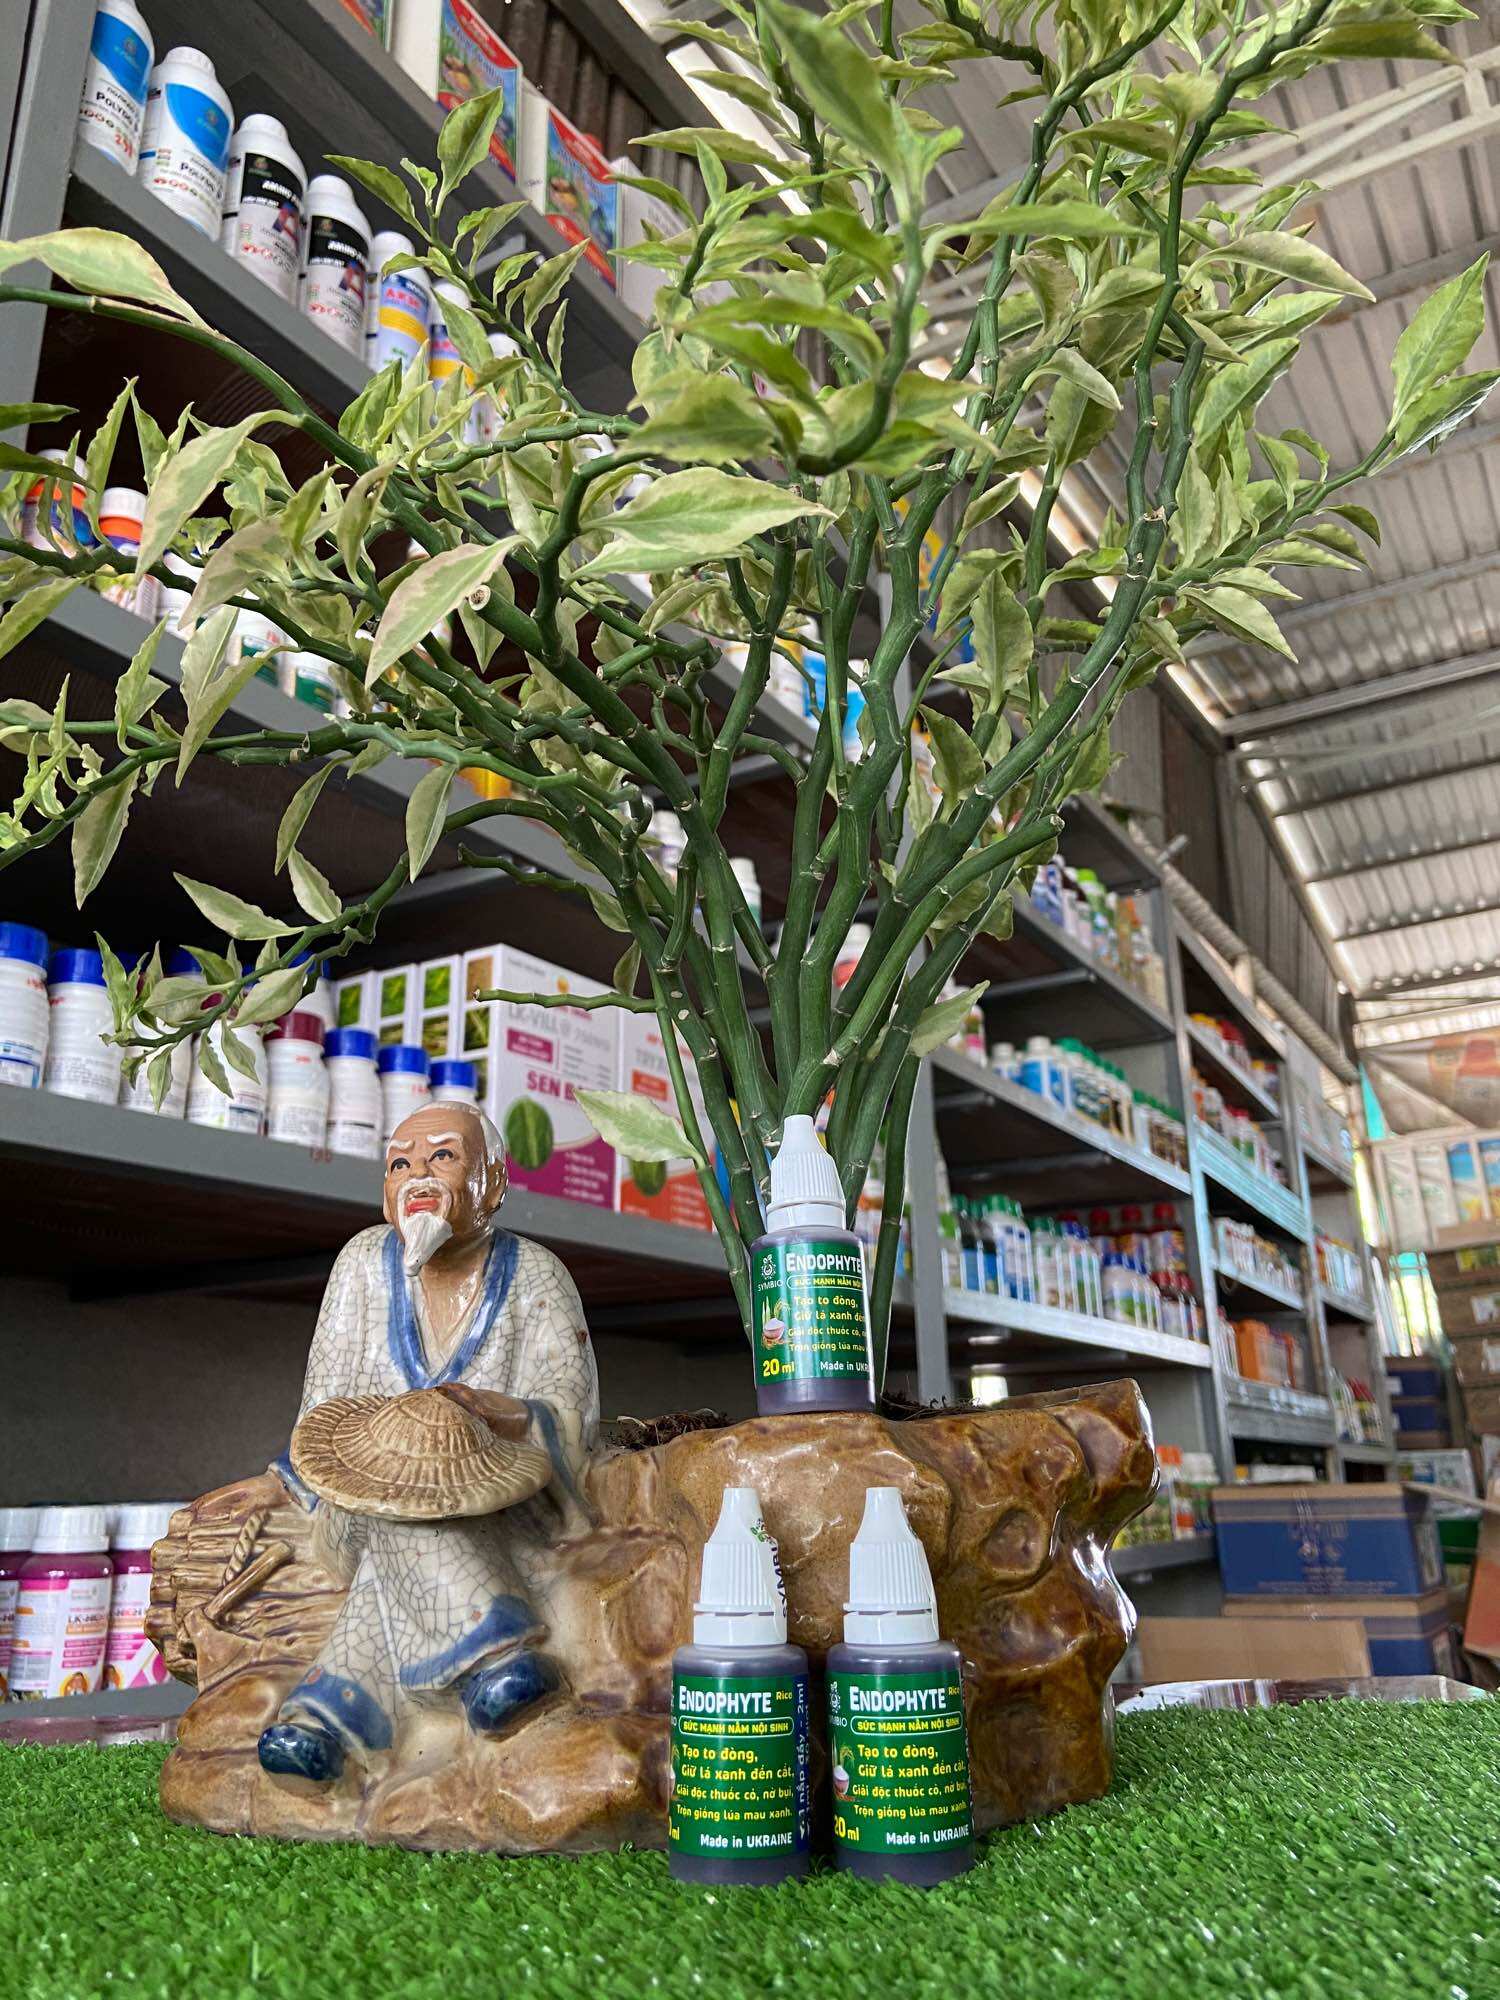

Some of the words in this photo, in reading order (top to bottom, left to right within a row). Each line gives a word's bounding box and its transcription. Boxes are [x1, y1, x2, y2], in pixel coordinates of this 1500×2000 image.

[786, 1253, 863, 1273] ENDOPHYTE
[818, 1297, 829, 1305] to
[829, 1311, 852, 1320] xanh
[763, 1358, 780, 1377] 20
[782, 1361, 795, 1374] ml
[820, 1361, 844, 1371] Made
[847, 1361, 854, 1371] in
[679, 1685, 772, 1714] ENDOPHYTE
[849, 1686, 947, 1712] ENDOPHYTE
[683, 1720, 698, 1730] SỨC
[700, 1723, 726, 1735] MẠNH
[752, 1722, 768, 1736] NỘI
[770, 1722, 789, 1732] SINH
[857, 1719, 876, 1731] SỨC
[879, 1721, 906, 1733] MẠNH
[931, 1717, 945, 1731] NỘI
[682, 1744, 700, 1760] Tạo
[703, 1748, 716, 1759] to
[720, 1747, 758, 1764] đòng,
[858, 1744, 880, 1760] Tạo
[884, 1747, 898, 1758] to
[902, 1745, 938, 1759] đòng,
[682, 1764, 697, 1777] Giữ
[700, 1766, 711, 1779] lá
[715, 1768, 746, 1780] xanh
[750, 1765, 773, 1780] đến
[858, 1764, 877, 1777] Giữ
[882, 1765, 894, 1778] lá
[899, 1766, 929, 1778] xanh
[932, 1760, 951, 1774] đến
[676, 1784, 689, 1796] Giải
[691, 1787, 707, 1801] độc
[710, 1786, 740, 1801] thuốc
[744, 1788, 760, 1801] cỏ,
[852, 1784, 869, 1797] Giải
[872, 1786, 890, 1800] độc
[894, 1783, 925, 1798] thuốc
[694, 1806, 720, 1822] giống
[723, 1809, 740, 1820] lúa
[744, 1812, 766, 1820] mau
[877, 1804, 906, 1820] giống
[910, 1805, 926, 1817] lúa
[929, 1806, 949, 1816] mau
[700, 1833, 729, 1848] Made
[733, 1836, 743, 1848] in
[746, 1831, 793, 1848] UKRAINE
[847, 1826, 860, 1842] ml
[886, 1832, 917, 1845] Made
[920, 1831, 930, 1844] in
[933, 1824, 969, 1843] UKRAINE
